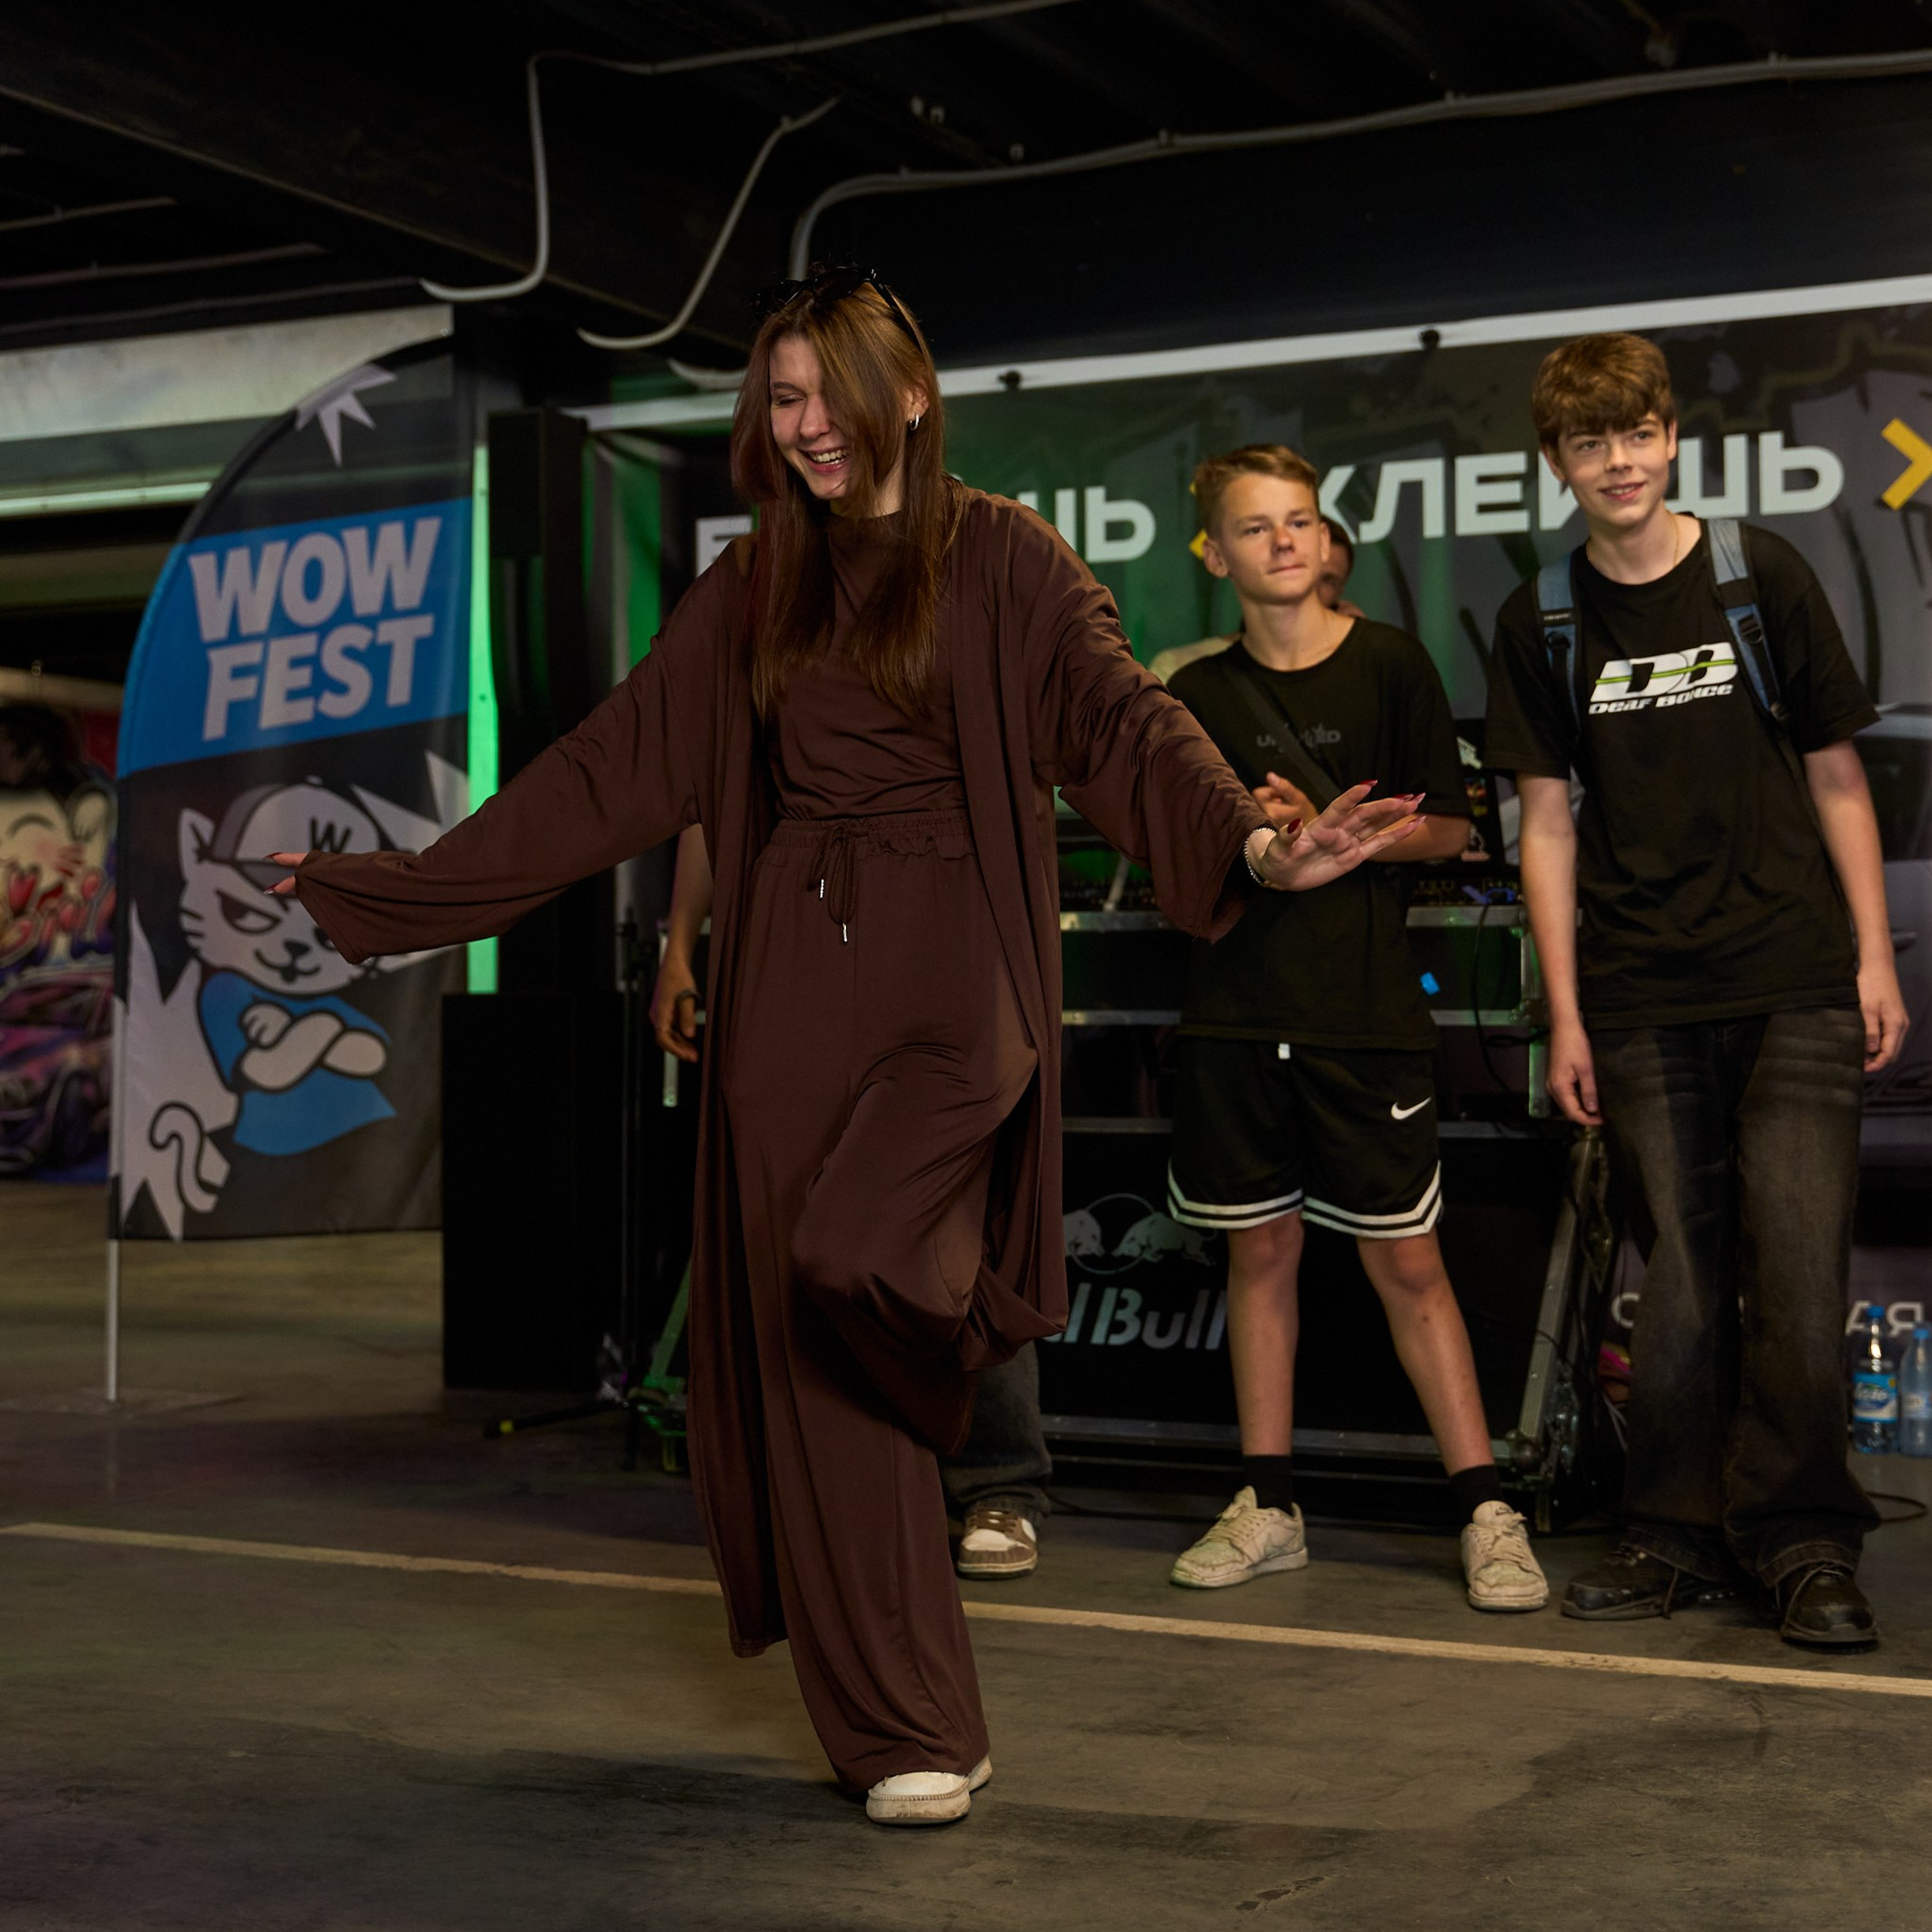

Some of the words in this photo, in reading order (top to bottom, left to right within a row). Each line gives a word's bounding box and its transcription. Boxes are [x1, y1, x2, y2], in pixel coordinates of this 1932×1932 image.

[189, 517, 441, 643] WOW
[203, 614, 434, 741] FEST
[310, 817, 352, 854] W
[1090, 1286, 1229, 1350] Bull
